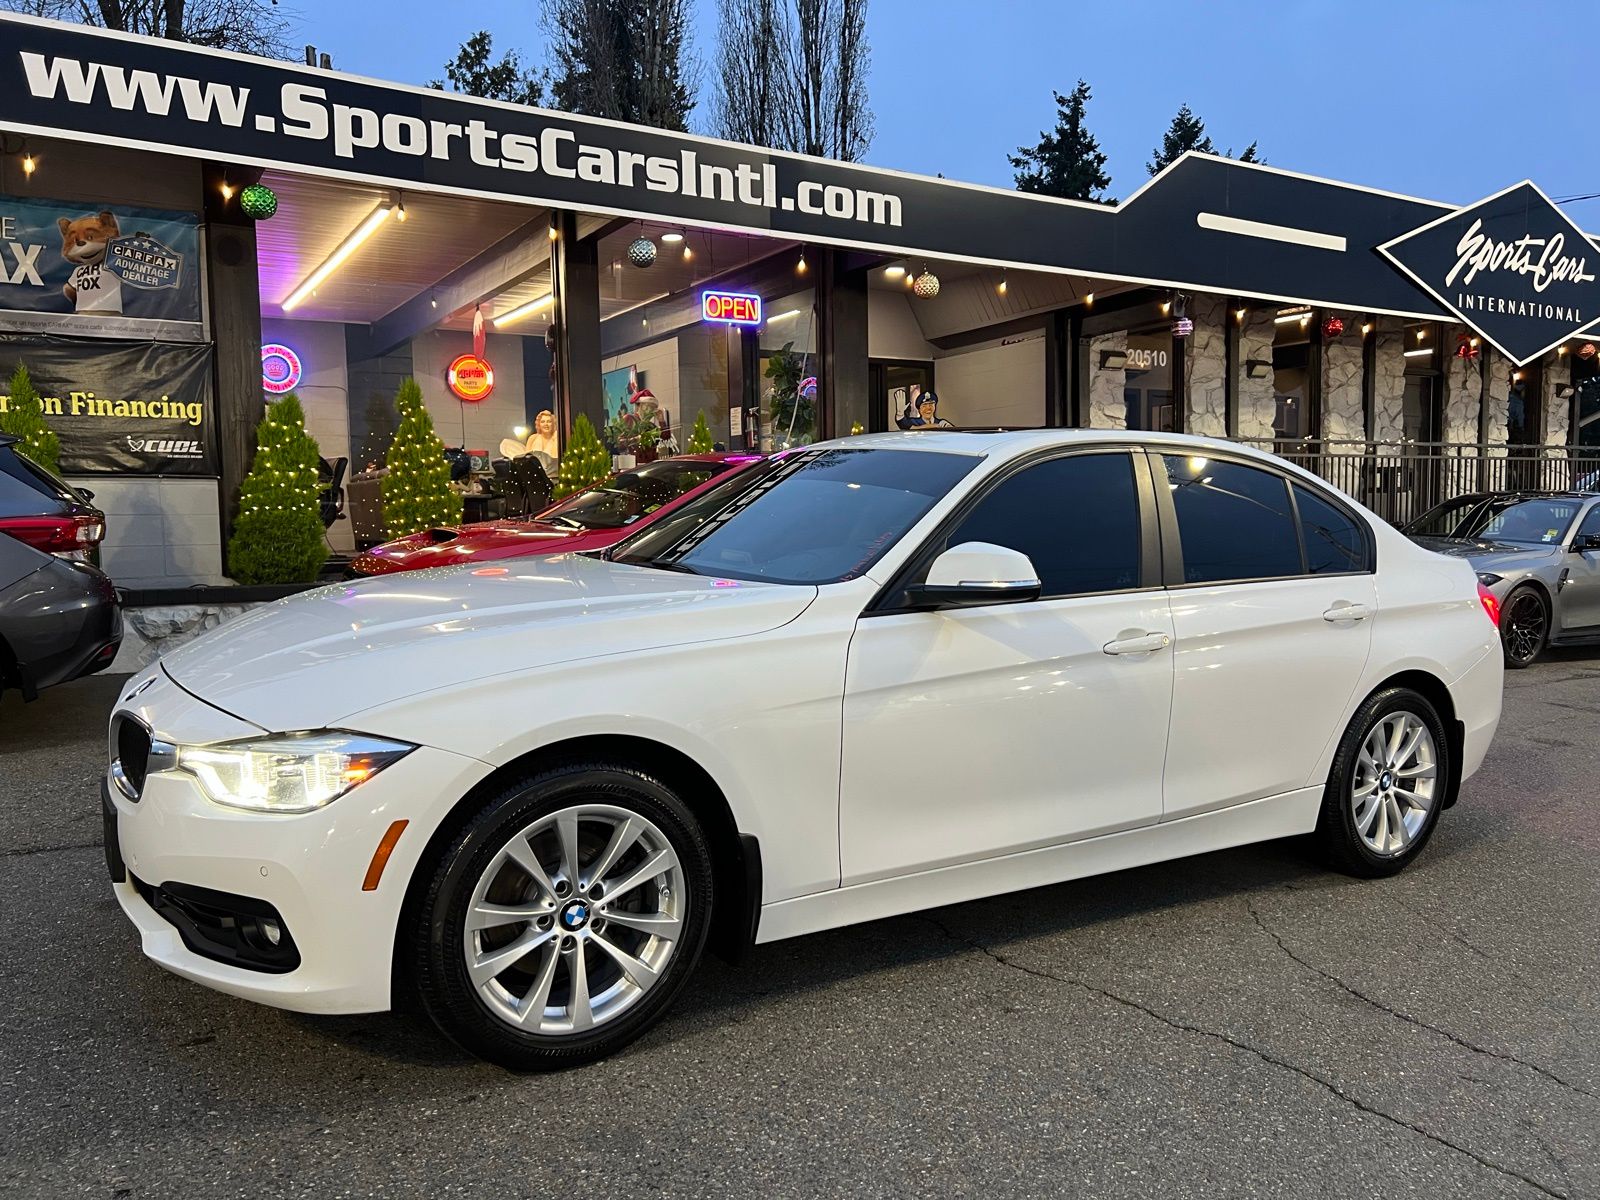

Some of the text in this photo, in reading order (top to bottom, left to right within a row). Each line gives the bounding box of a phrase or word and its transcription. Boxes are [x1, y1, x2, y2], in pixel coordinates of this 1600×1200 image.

[19, 50, 903, 227] www.SportsCarsIntl.com
[113, 246, 175, 270] CARFAX
[115, 258, 170, 279] ADVANTAGE
[76, 263, 101, 278] CAR
[122, 270, 159, 287] DEALER
[76, 276, 101, 291] FOX
[706, 295, 758, 320] OPEN
[1458, 293, 1582, 323] INTERNATIONAL
[1126, 349, 1167, 367] 20510
[70, 392, 203, 426] Financing
[144, 440, 203, 453] CUDL
